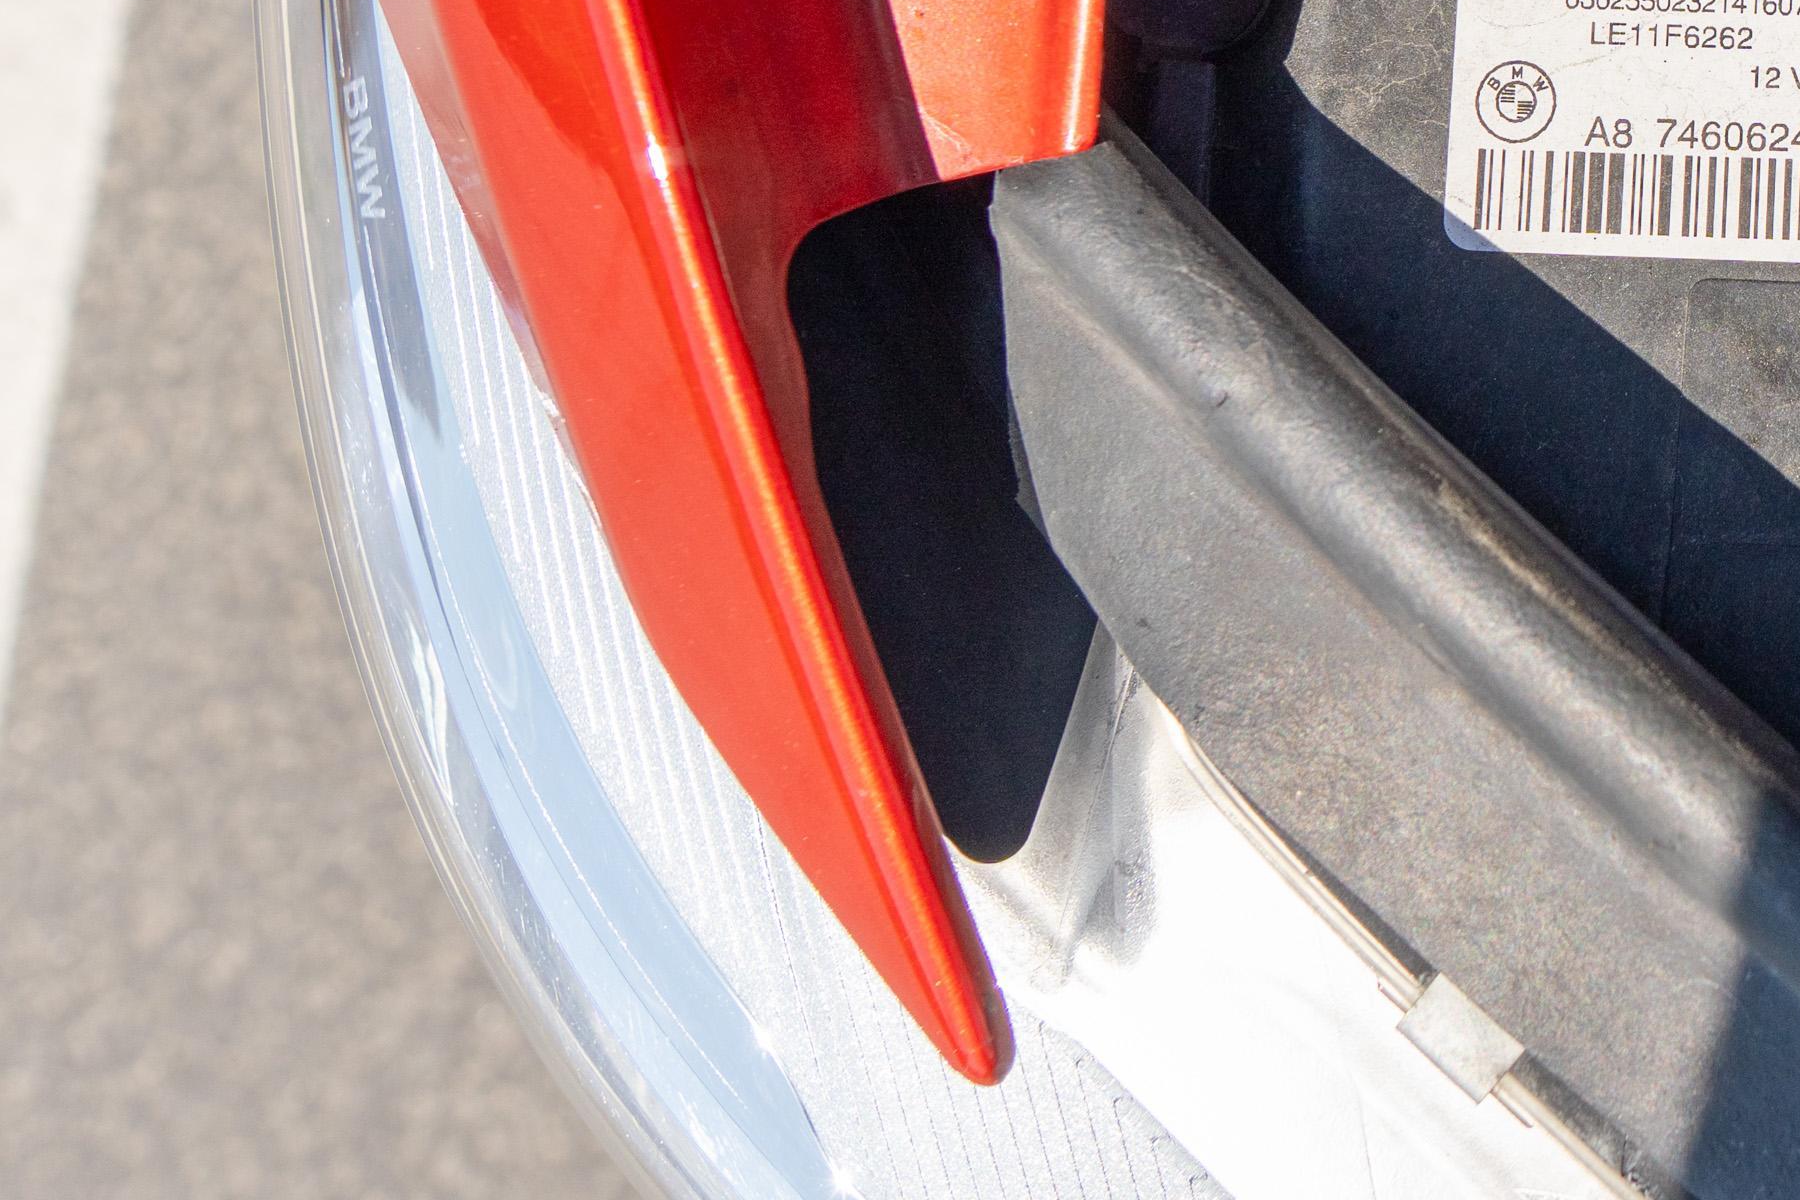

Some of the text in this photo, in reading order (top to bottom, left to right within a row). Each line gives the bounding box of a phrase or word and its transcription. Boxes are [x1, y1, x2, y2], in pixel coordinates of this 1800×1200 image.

[1590, 21, 1754, 50] LE11F6262
[1486, 65, 1549, 92] BMW
[1751, 65, 1781, 89] 12
[1584, 115, 1634, 149] A8
[343, 75, 387, 219] BMW
